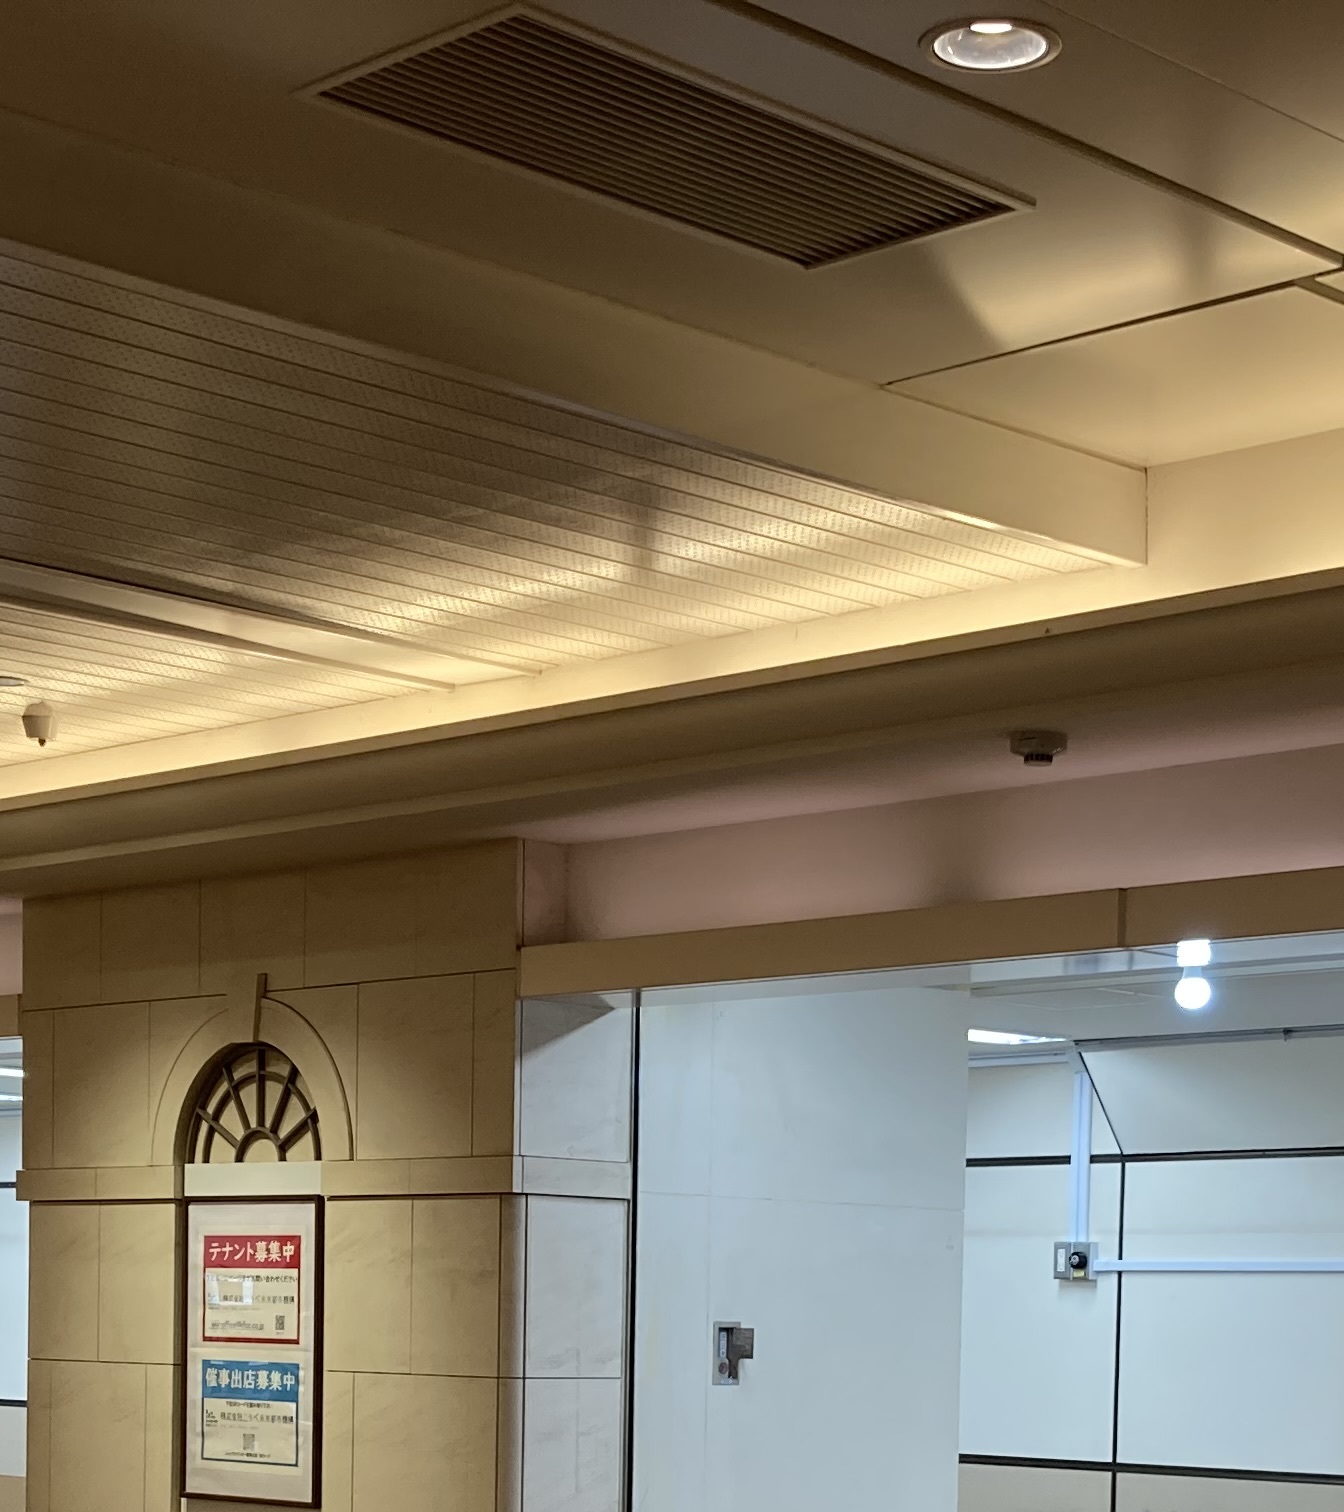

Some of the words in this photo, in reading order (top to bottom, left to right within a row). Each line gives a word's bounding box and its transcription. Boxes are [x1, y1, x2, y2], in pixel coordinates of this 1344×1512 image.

[209, 1240, 294, 1262] テナント募集中
[206, 1368, 295, 1391] 催事出店募集中
